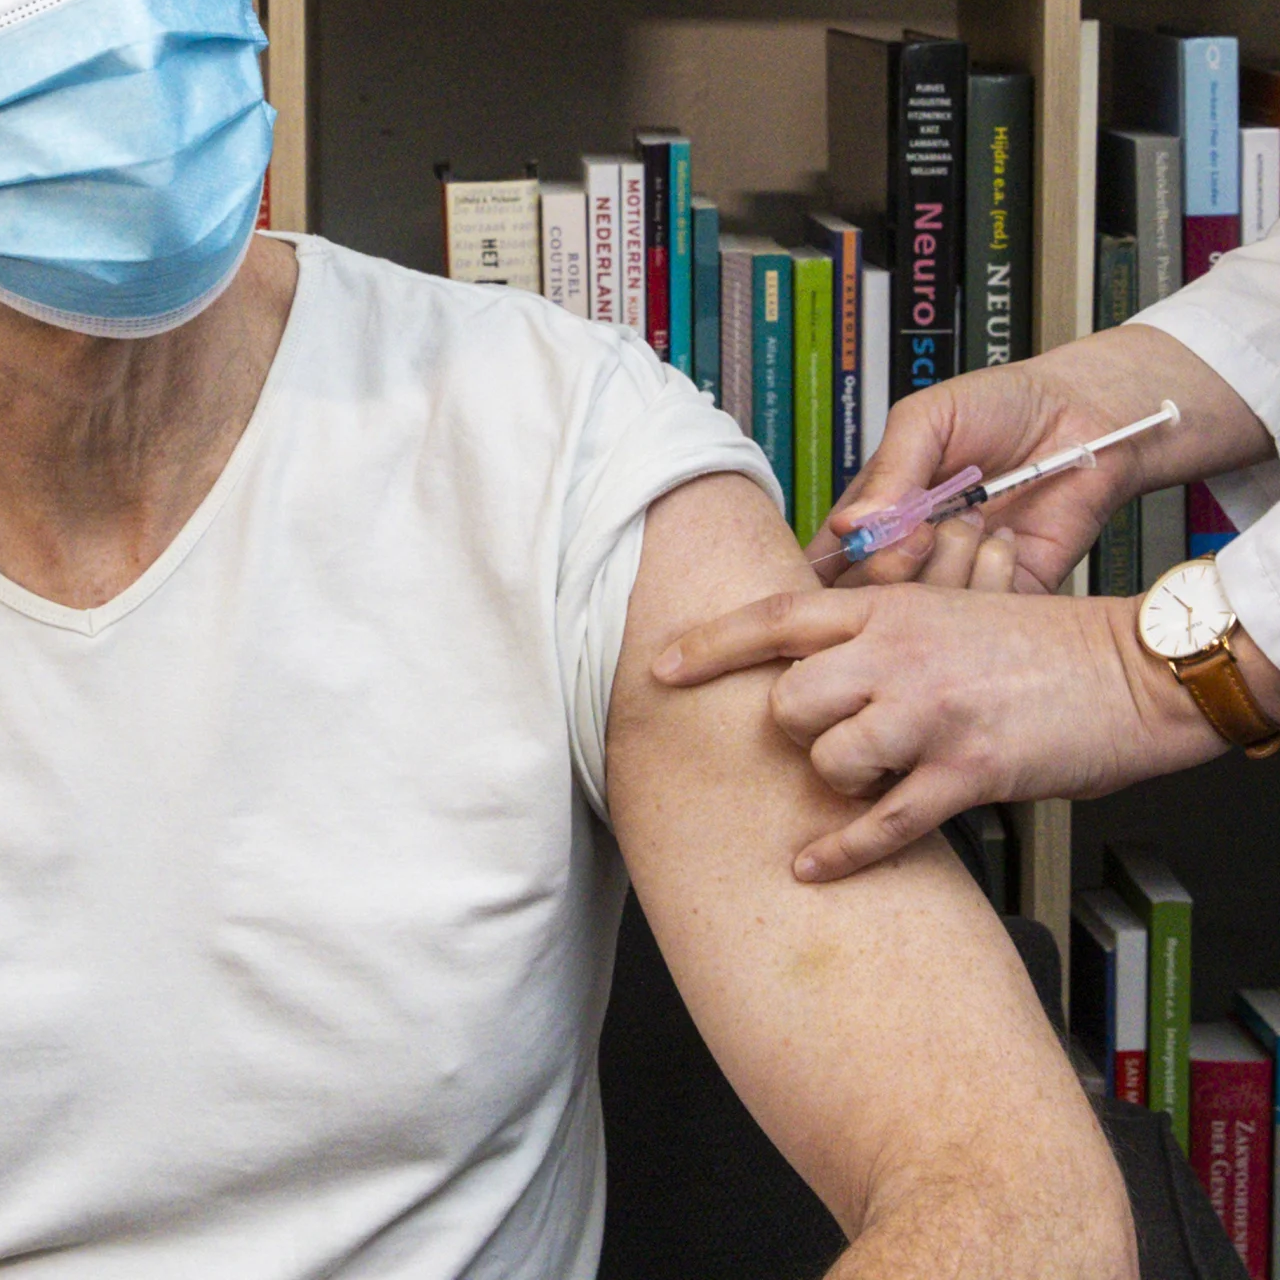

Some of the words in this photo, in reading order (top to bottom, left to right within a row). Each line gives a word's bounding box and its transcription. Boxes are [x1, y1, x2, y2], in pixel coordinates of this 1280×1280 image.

[990, 125, 1010, 173] Hijdra
[993, 177, 1006, 205] e.a.
[627, 178, 642, 289] MOTIVEREN
[989, 209, 1009, 250] (red.)
[481, 238, 499, 269] HET
[912, 202, 945, 327] Neuro
[567, 252, 581, 298] ROEL
[628, 295, 640, 326] KUN
[986, 261, 1013, 364] NEUR
[766, 336, 779, 365] Atlas
[840, 375, 857, 468] Oogheelkunde
[1124, 1058, 1140, 1088] SAN
[1210, 1120, 1227, 1155] DER
